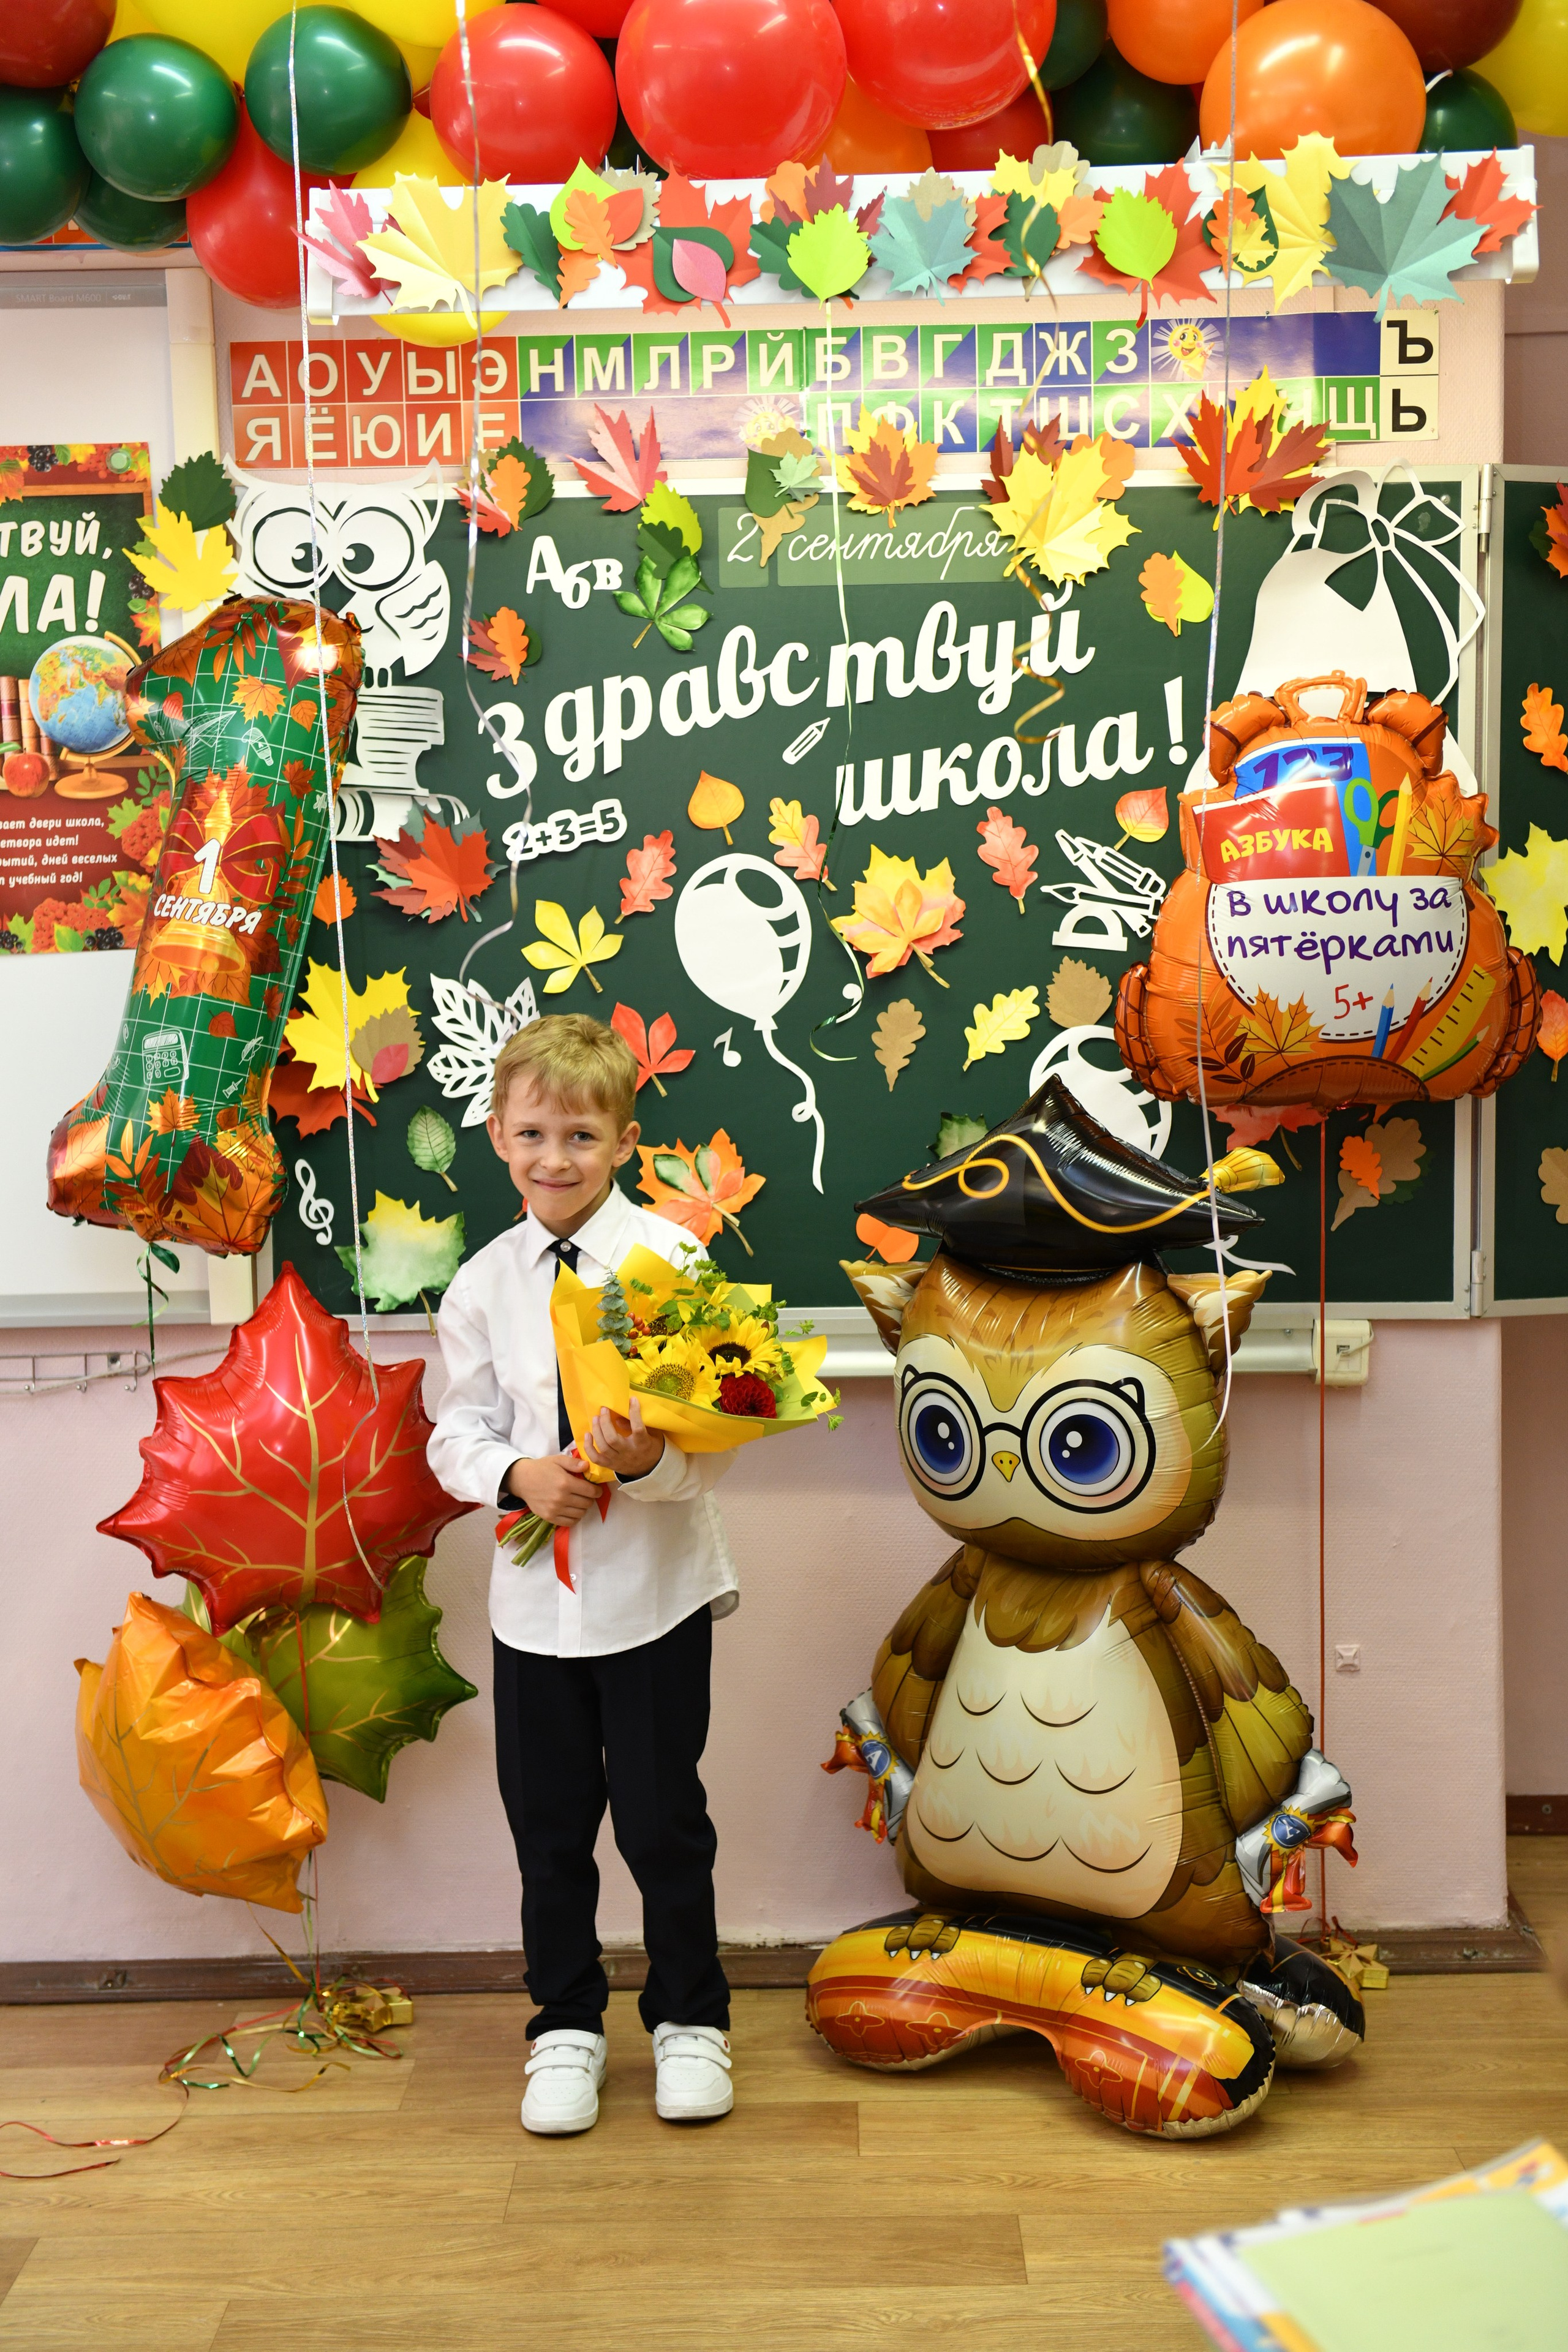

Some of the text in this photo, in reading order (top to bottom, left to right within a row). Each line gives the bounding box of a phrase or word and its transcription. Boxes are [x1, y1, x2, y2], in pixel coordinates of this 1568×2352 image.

[241, 354, 282, 398] А
[298, 353, 339, 397] О
[355, 352, 391, 395] У
[407, 351, 456, 395] Ы
[529, 349, 564, 393] Н
[583, 347, 630, 391] М
[644, 345, 681, 390] Л
[703, 344, 735, 388] Р
[873, 335, 910, 379] В
[933, 334, 956, 378] Г
[985, 333, 1028, 386] Д
[1104, 328, 1138, 373] З
[1387, 320, 1434, 364] Ъ
[246, 418, 281, 462] Я
[353, 414, 401, 459] Ю
[417, 413, 452, 456] И
[933, 400, 965, 444] К
[1329, 386, 1376, 439] Щ
[1392, 388, 1427, 432] Ь
[788, 506, 1009, 580] сентября
[29, 817, 62, 831] двери
[66, 817, 105, 827] школа,
[46, 834, 78, 846] идет!
[41, 854, 68, 865] дней
[72, 854, 118, 864] веселых
[1219, 827, 1334, 864] АЗБУКА
[9, 873, 56, 888] учебный
[60, 872, 83, 883] год!
[194, 838, 221, 894] 1
[154, 894, 262, 935] СЕНТЯБРЯ
[1227, 887, 1452, 927] В школу за
[1227, 929, 1453, 974] пятёрками
